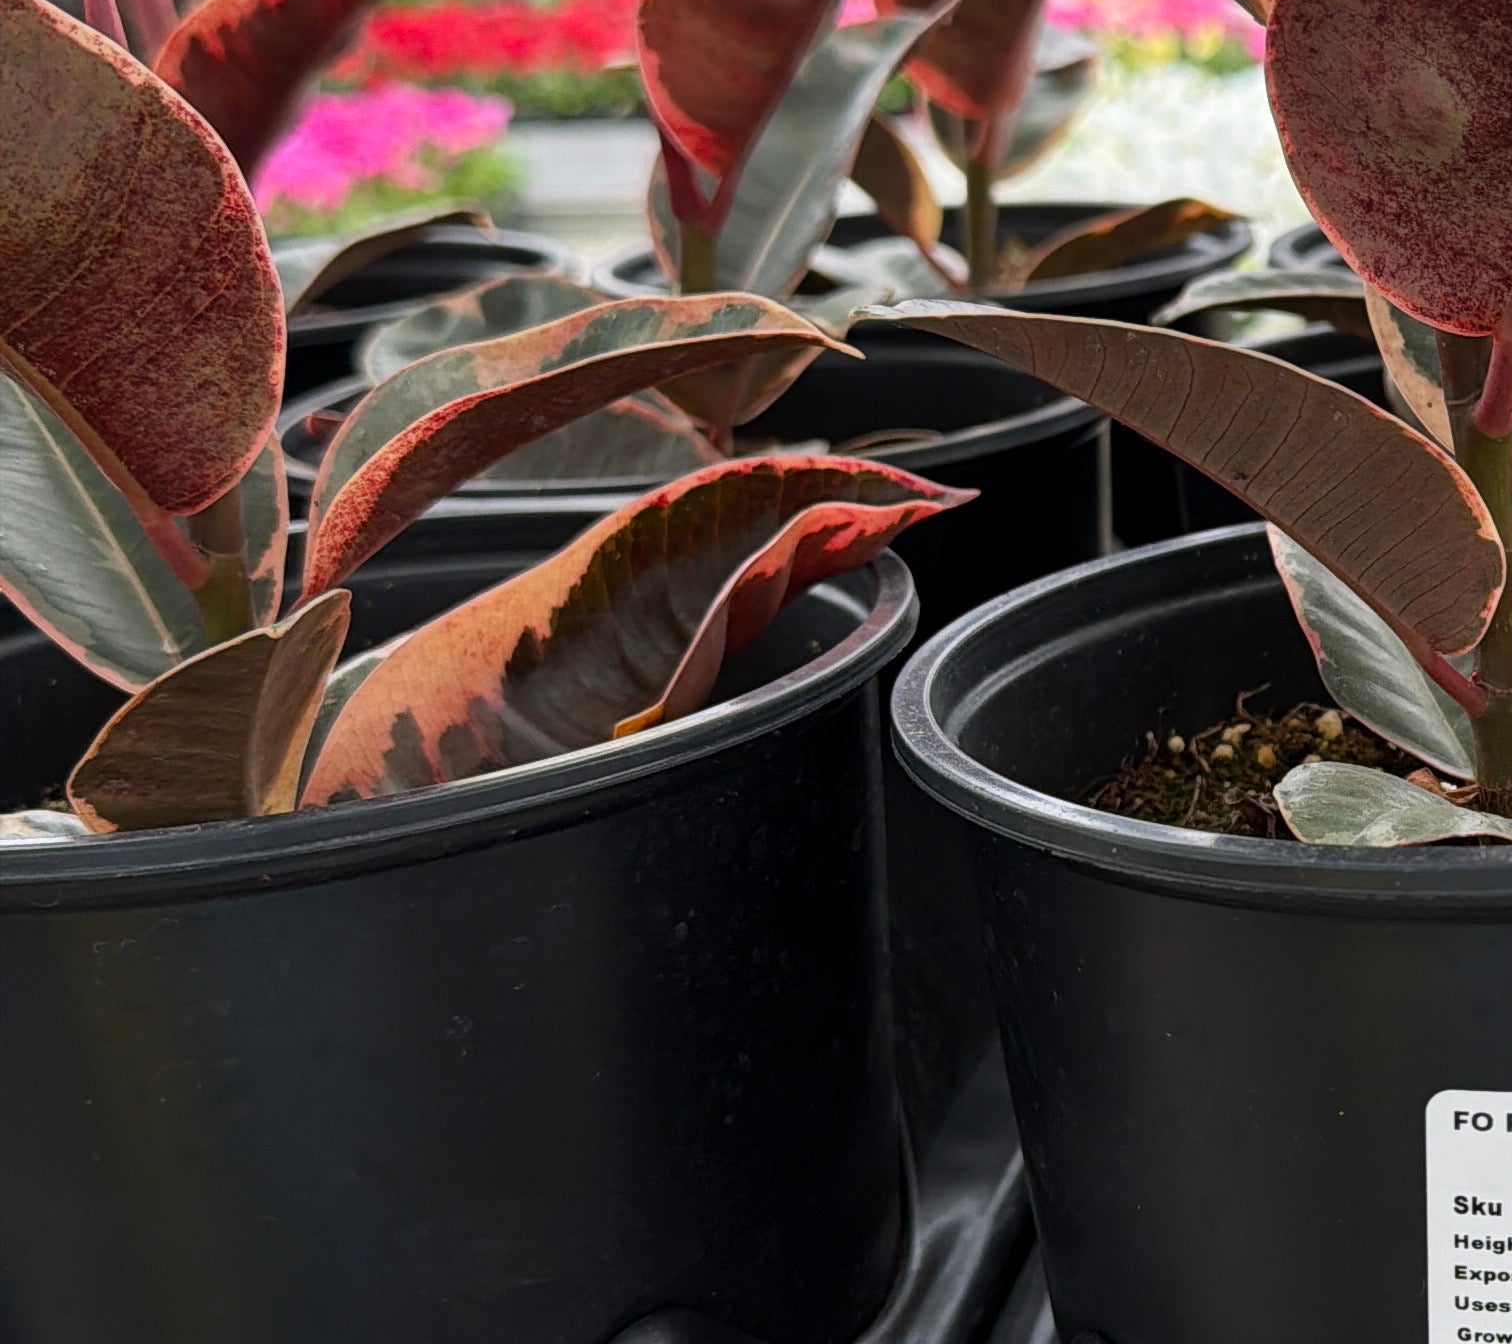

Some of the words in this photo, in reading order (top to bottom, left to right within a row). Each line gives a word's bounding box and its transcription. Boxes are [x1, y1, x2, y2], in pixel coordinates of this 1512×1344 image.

[1453, 1110, 1494, 1132] FO
[1453, 1195, 1502, 1216] Sku
[1454, 1295, 1512, 1313] Uses
